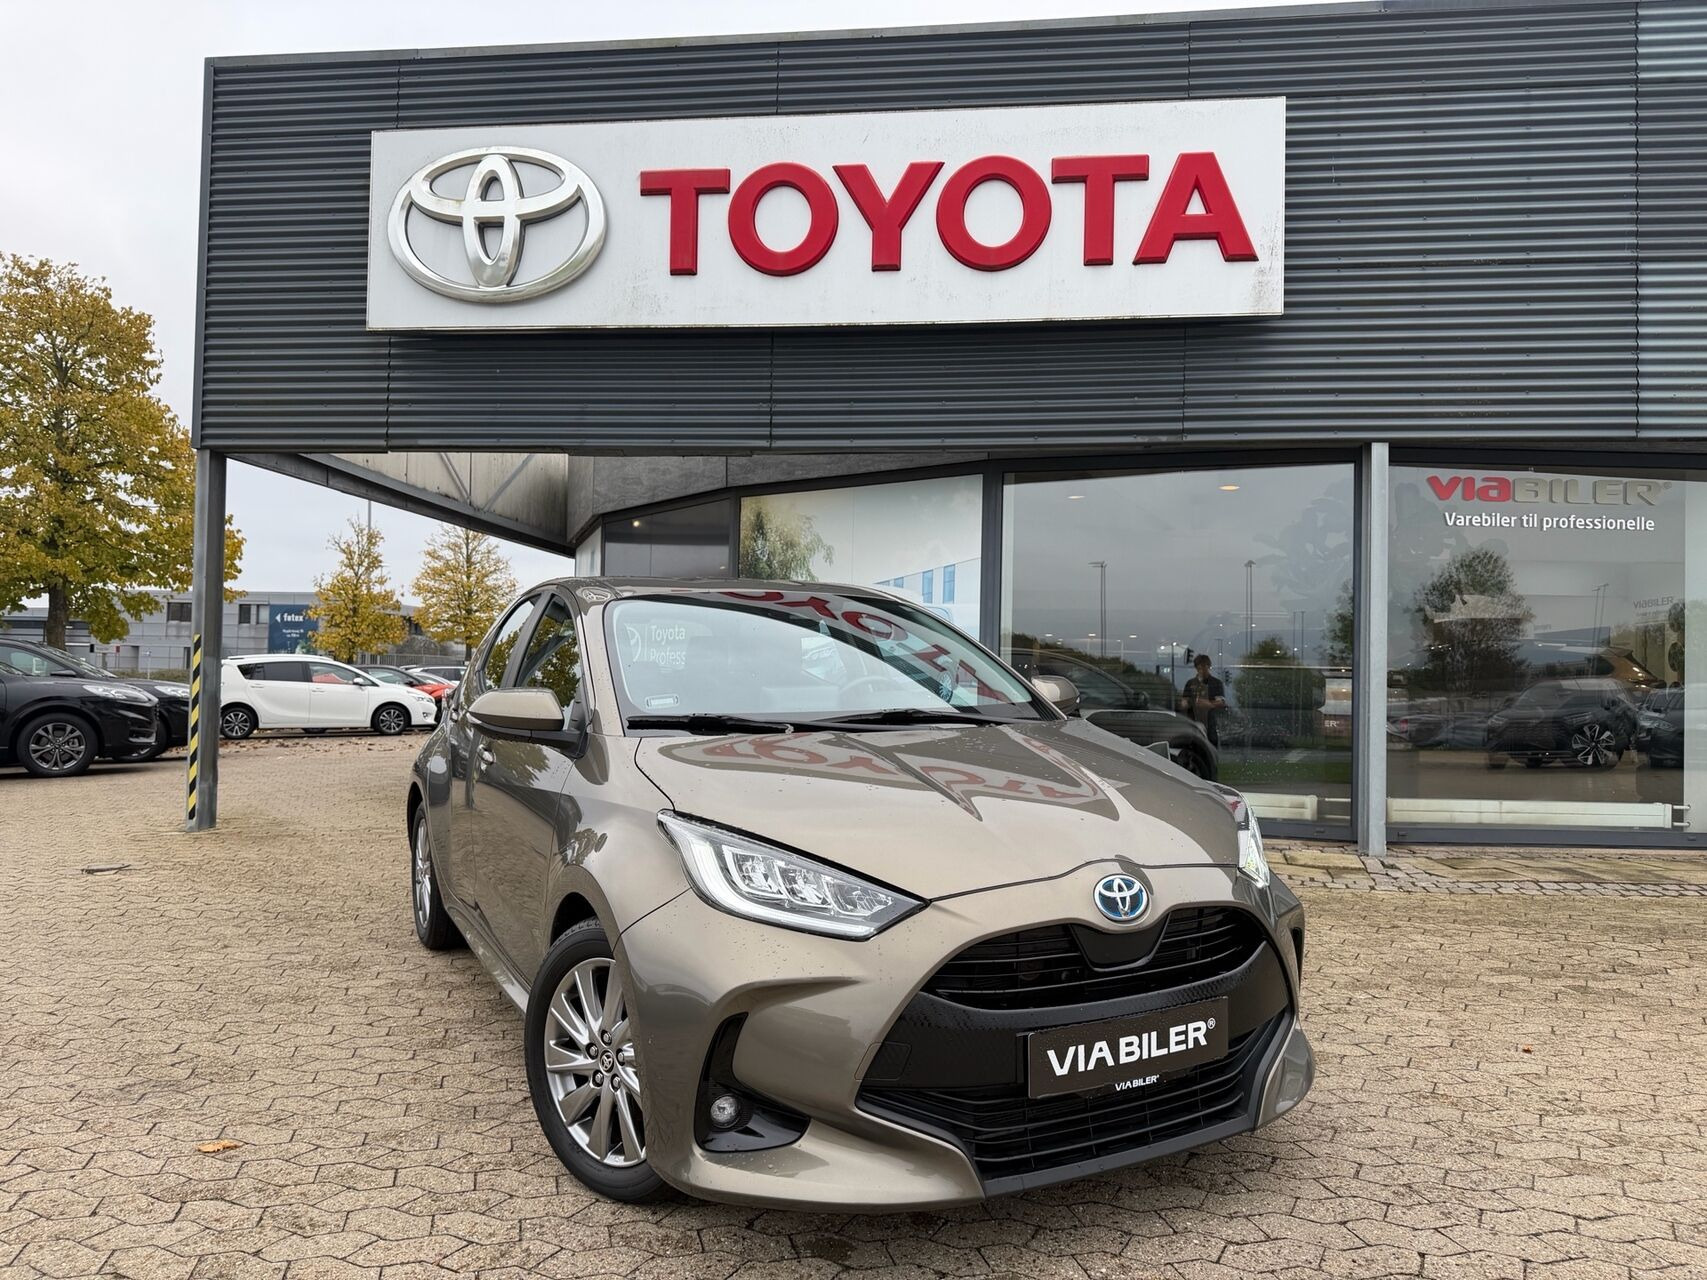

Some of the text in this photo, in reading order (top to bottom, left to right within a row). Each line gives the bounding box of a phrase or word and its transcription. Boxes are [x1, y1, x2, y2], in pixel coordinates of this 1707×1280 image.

[640, 151, 1259, 277] TOYOTA
[1445, 512, 1655, 531] Varebiler til professionelle
[650, 624, 686, 645] Toyota
